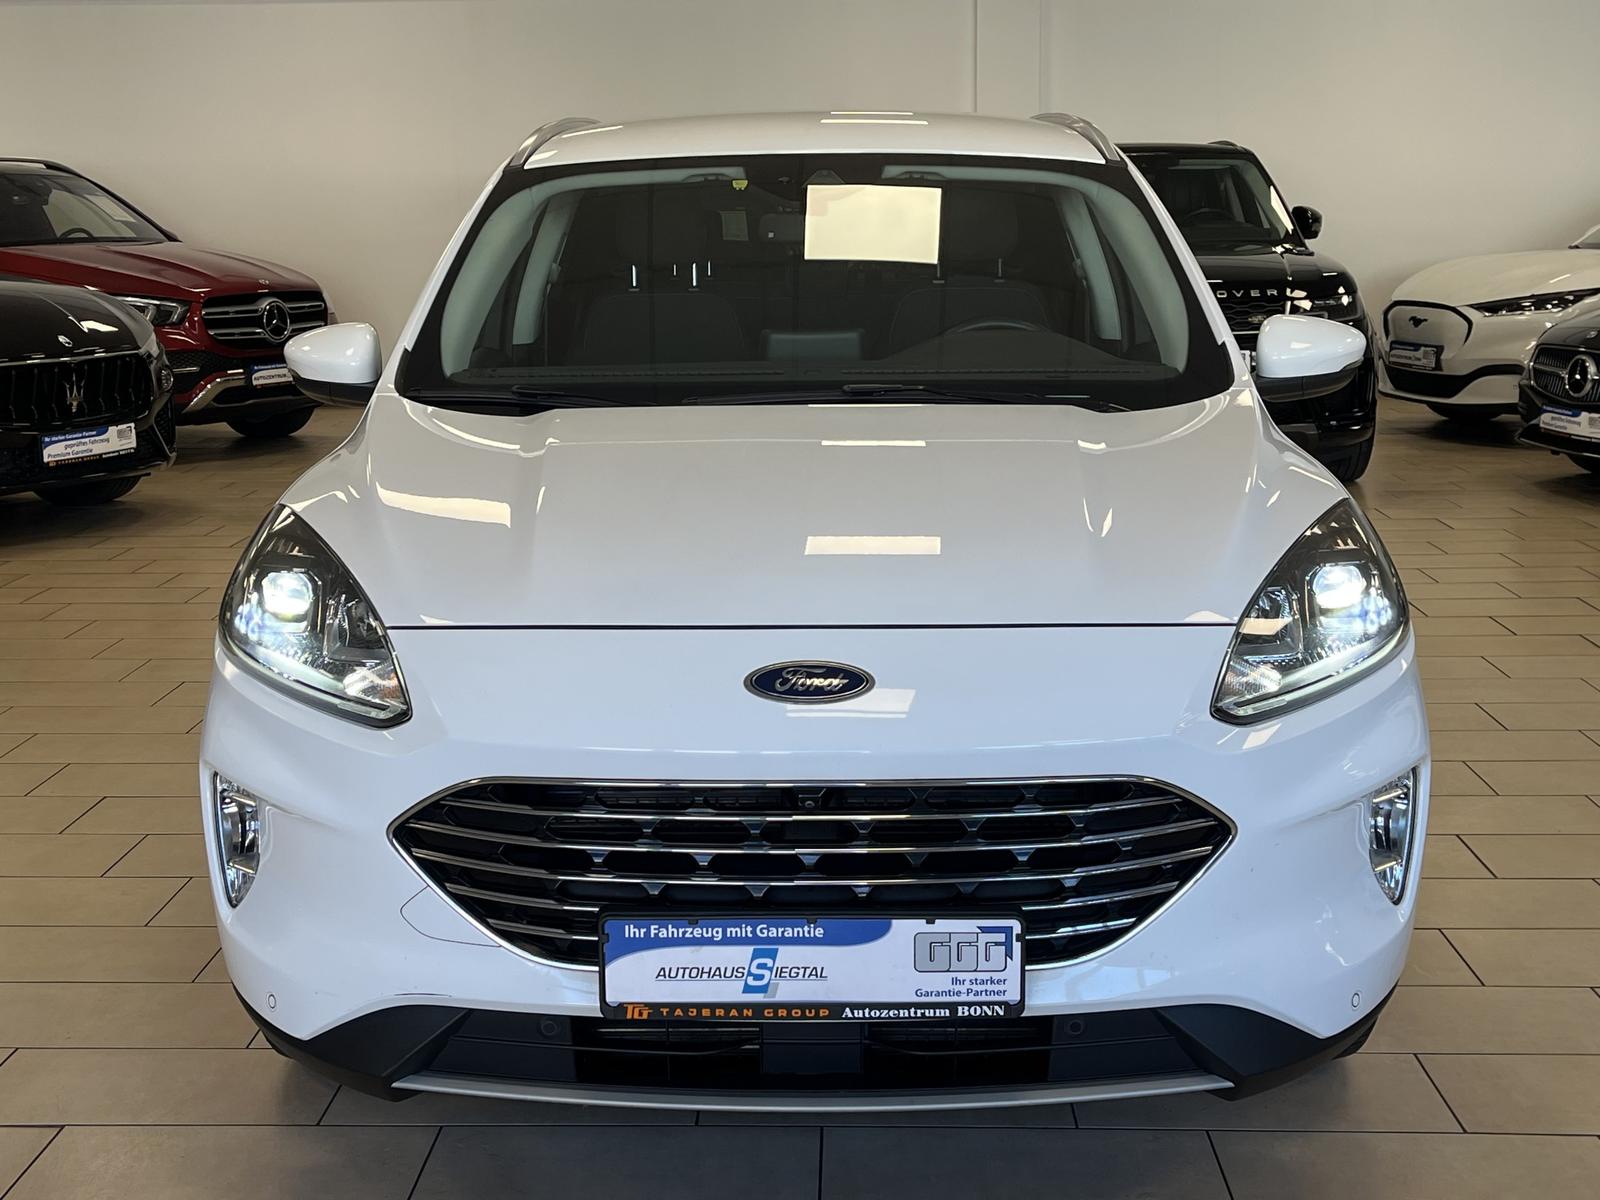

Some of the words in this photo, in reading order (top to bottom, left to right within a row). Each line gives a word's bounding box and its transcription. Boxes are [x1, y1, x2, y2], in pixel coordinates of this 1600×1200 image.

[1216, 288, 1278, 298] OVER
[775, 667, 849, 691] Ford
[624, 924, 647, 938] Ihr
[650, 924, 723, 941] Fahrzeug
[726, 924, 753, 938] mit
[756, 924, 824, 938] Garantie
[655, 966, 746, 979] AUTOHAUS
[951, 976, 966, 986] Ihr
[968, 976, 1008, 986] starker
[915, 987, 1008, 998] Garantie-Partner
[660, 1007, 753, 1017] TAJERAN
[764, 1007, 830, 1017] GROUP
[841, 1006, 950, 1018] Autozentrum
[957, 1005, 1005, 1017] BONN
